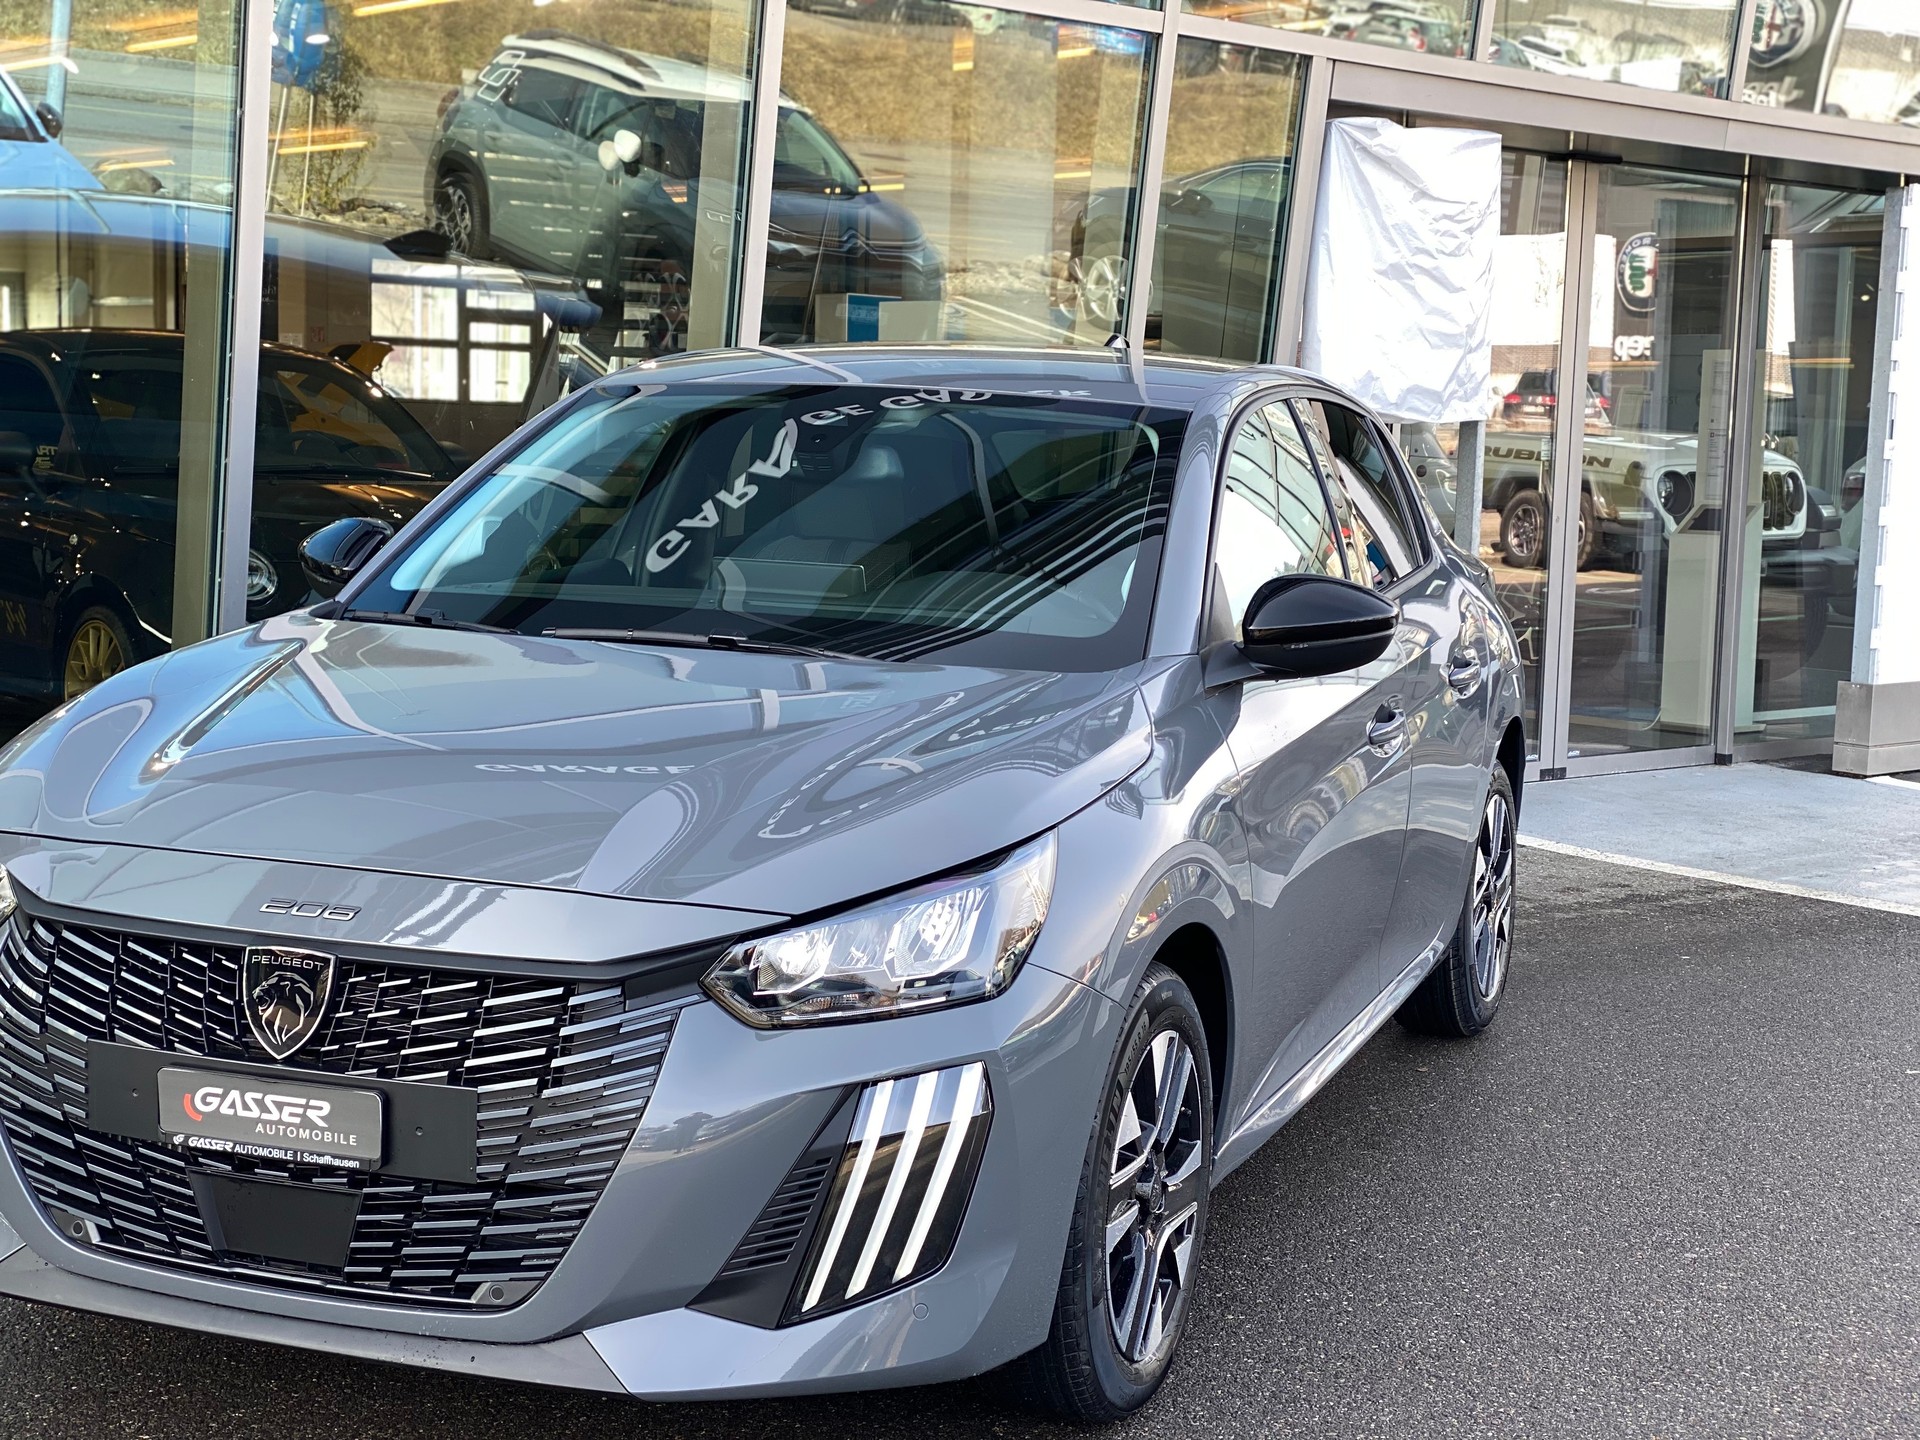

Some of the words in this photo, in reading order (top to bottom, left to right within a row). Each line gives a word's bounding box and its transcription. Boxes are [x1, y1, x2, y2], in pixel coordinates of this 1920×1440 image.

[259, 898, 362, 921] 208
[251, 955, 324, 971] PEUGEOT
[193, 1086, 331, 1128] GASSER
[255, 1122, 357, 1146] AUTOMOBILE
[188, 1136, 234, 1152] GASSER
[234, 1144, 294, 1160] AUTOMOBILE
[302, 1152, 360, 1169] Schaffhausen
